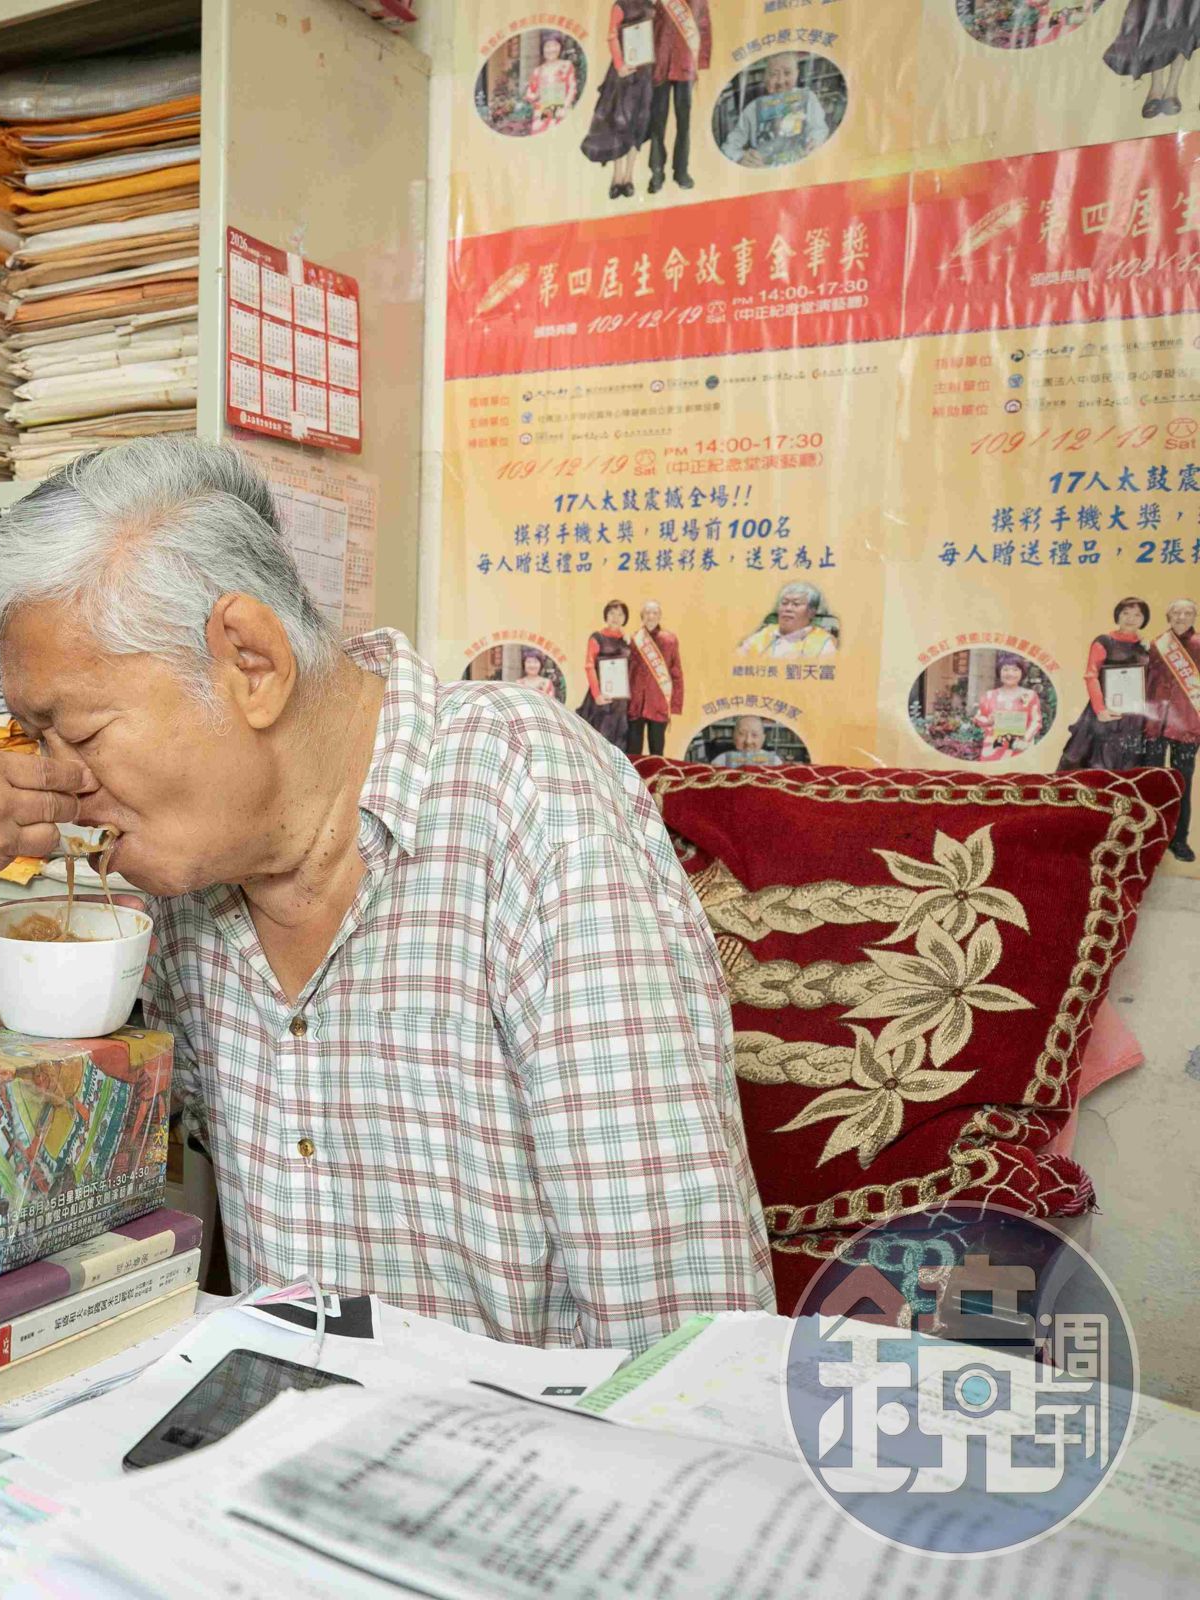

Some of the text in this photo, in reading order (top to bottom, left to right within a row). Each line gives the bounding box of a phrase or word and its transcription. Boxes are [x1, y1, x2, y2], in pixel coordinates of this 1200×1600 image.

[538, 223, 869, 308] 第四屆生命故事金筆獎
[759, 279, 869, 302] 14:00-17:30
[664, 432, 824, 456] PM 14:00-17:30
[970, 424, 1159, 455] 109/12/19
[497, 454, 628, 480] 109/12/19
[991, 502, 1200, 534] 摸彩手機大獎，
[785, 663, 836, 681] 劉天富
[702, 694, 803, 721] 司馬中原文學家
